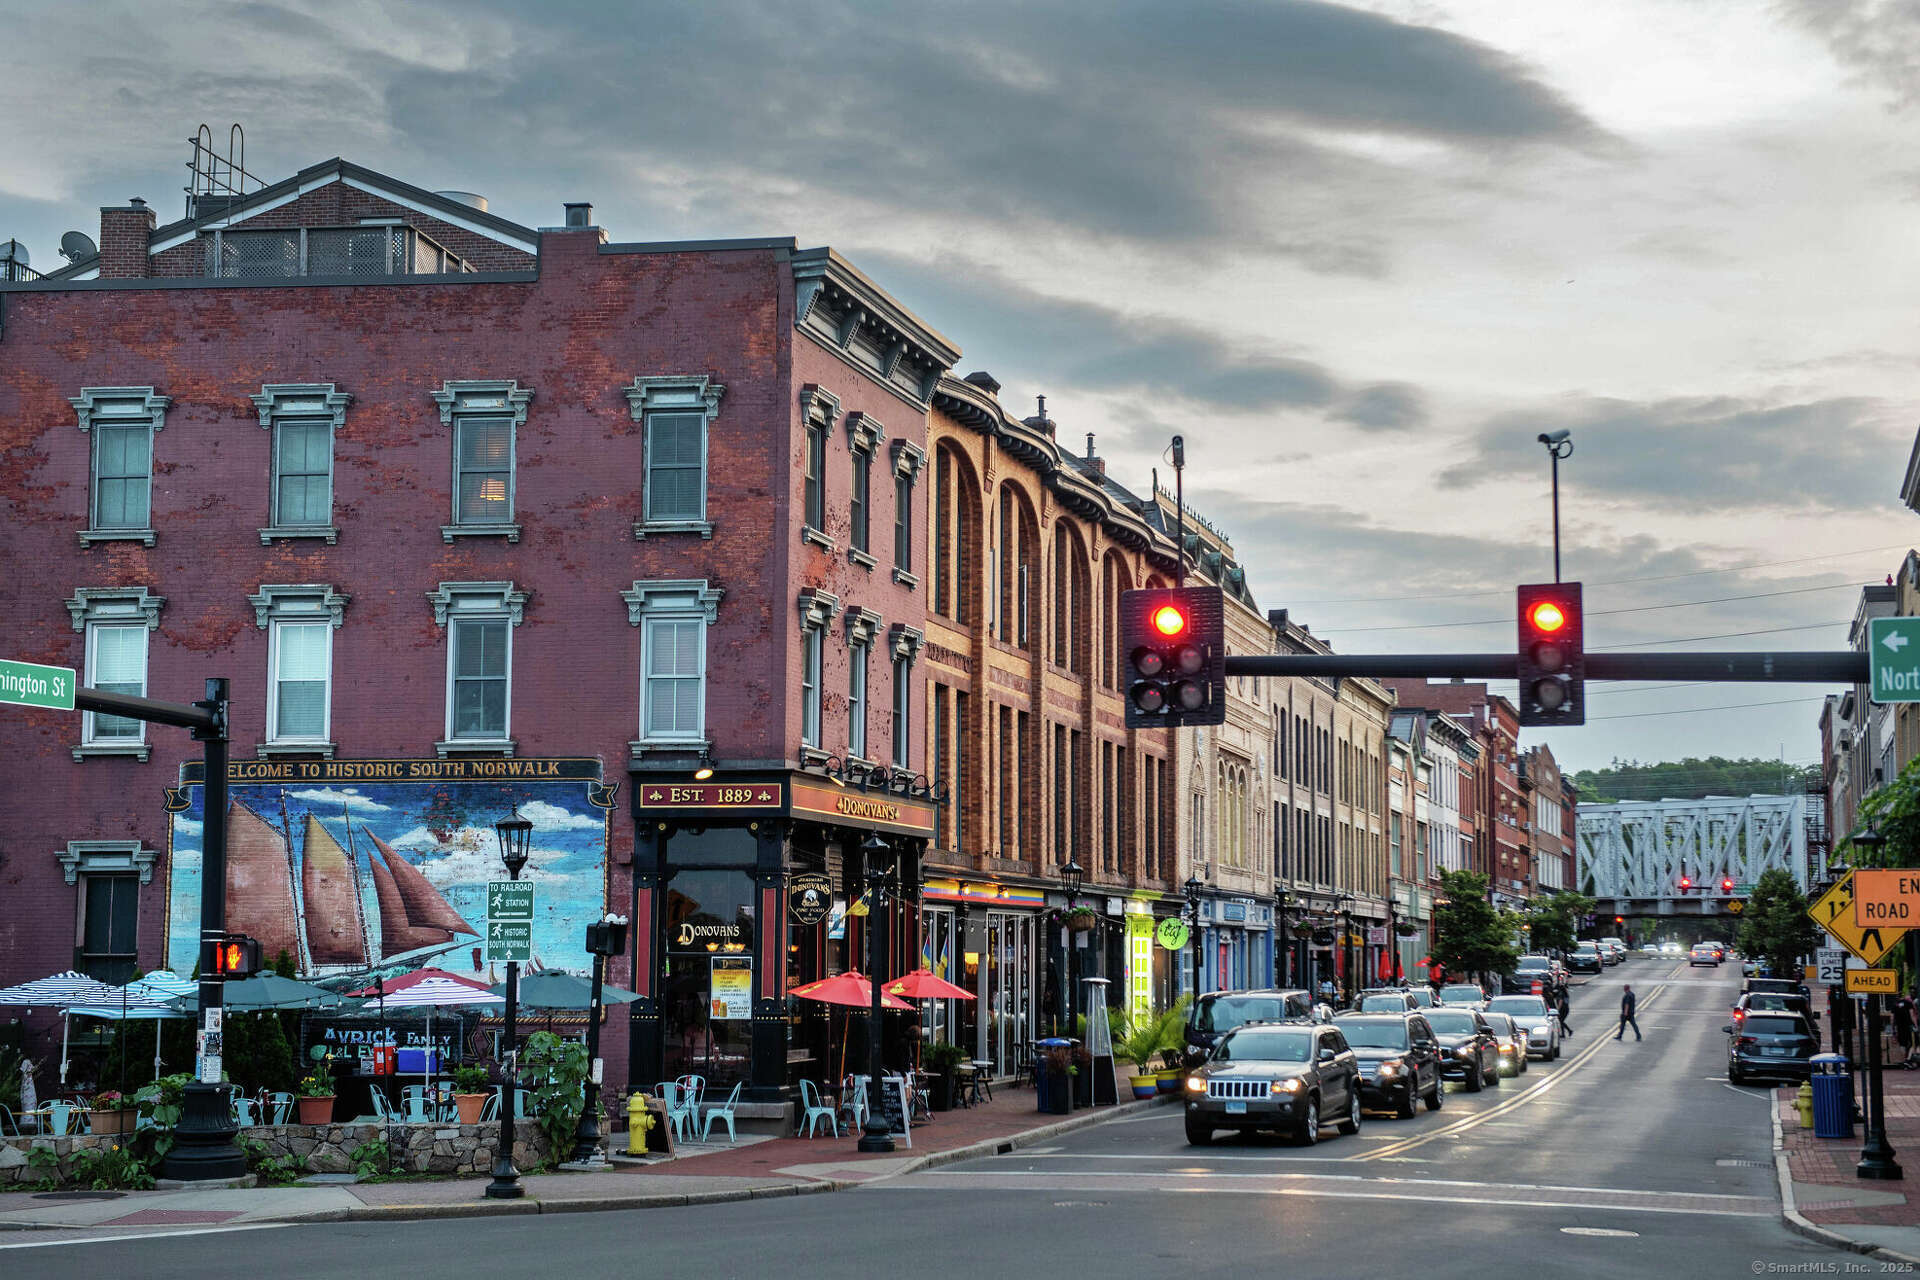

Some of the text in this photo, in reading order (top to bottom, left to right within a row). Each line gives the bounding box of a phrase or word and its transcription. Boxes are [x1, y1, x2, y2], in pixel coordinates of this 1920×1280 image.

[52, 676, 66, 698] St
[228, 761, 560, 777] ELCOME TO HISTORIC SOUTH NORWALK
[670, 787, 753, 803] EST. 1889
[843, 797, 895, 820] DONOVAN'S
[490, 883, 532, 892] TO RAILROAD
[791, 882, 830, 895] DONOVAN'S
[505, 899, 529, 907] STATION
[1866, 902, 1909, 919] ROAD
[504, 928, 528, 936] HISTORIC
[680, 923, 740, 945] DONOVAN'S
[489, 940, 529, 948] SOUTH NORWALK
[1820, 967, 1843, 980] 25
[1853, 976, 1891, 986] AHEAD
